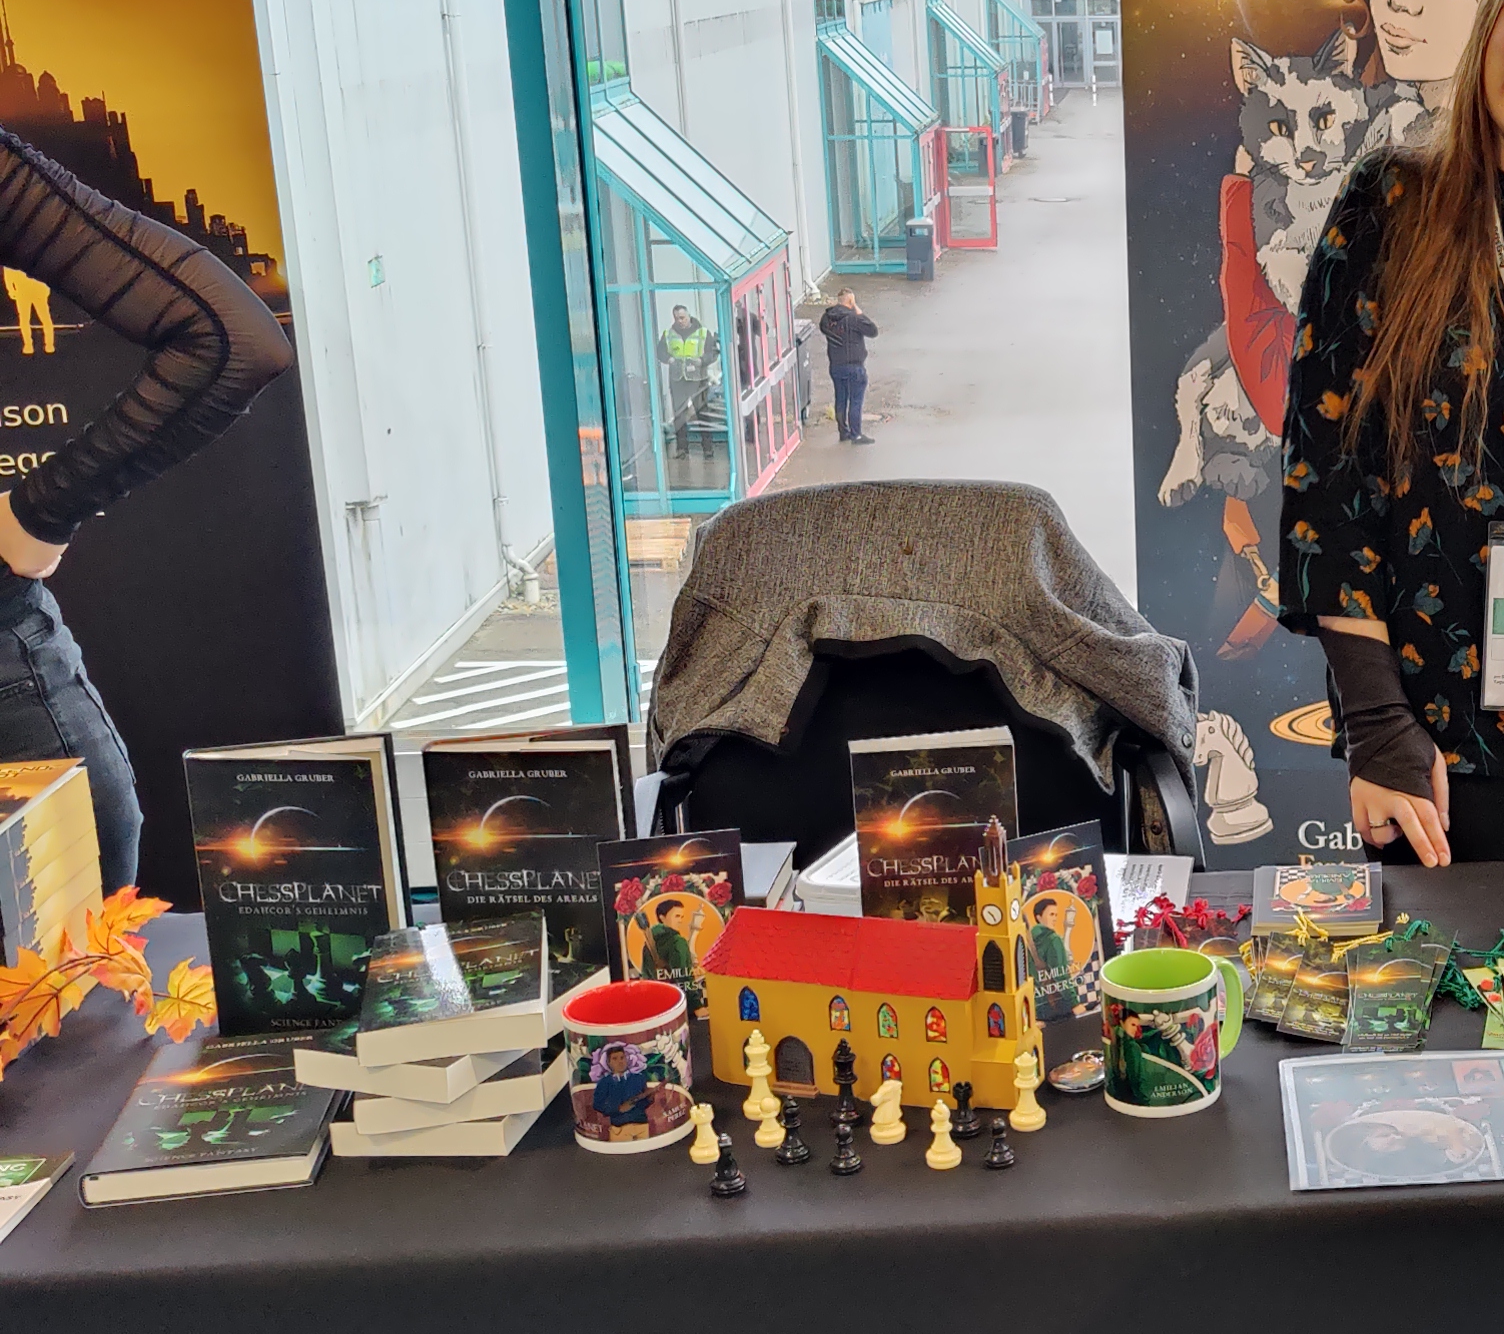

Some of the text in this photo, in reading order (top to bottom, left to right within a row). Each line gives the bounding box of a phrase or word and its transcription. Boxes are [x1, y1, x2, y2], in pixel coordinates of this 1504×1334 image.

[0, 402, 69, 427] son
[468, 769, 568, 779] GABRIELLA GRUBER
[890, 766, 976, 777] GABRIELLA GRUBER
[236, 773, 335, 783] GABRIELLA GRUBER
[1298, 820, 1364, 850] Gab
[866, 854, 983, 877] CHESSPLAN
[446, 868, 601, 893] CHESSPLANE
[884, 880, 900, 888] DIE
[902, 876, 939, 887] RÄTSEL
[961, 876, 974, 884] AR
[467, 893, 598, 904] DIE RÄTSEL DES AREALS
[314, 1019, 343, 1028] FANT
[137, 1082, 305, 1107] CHESSPLAN
